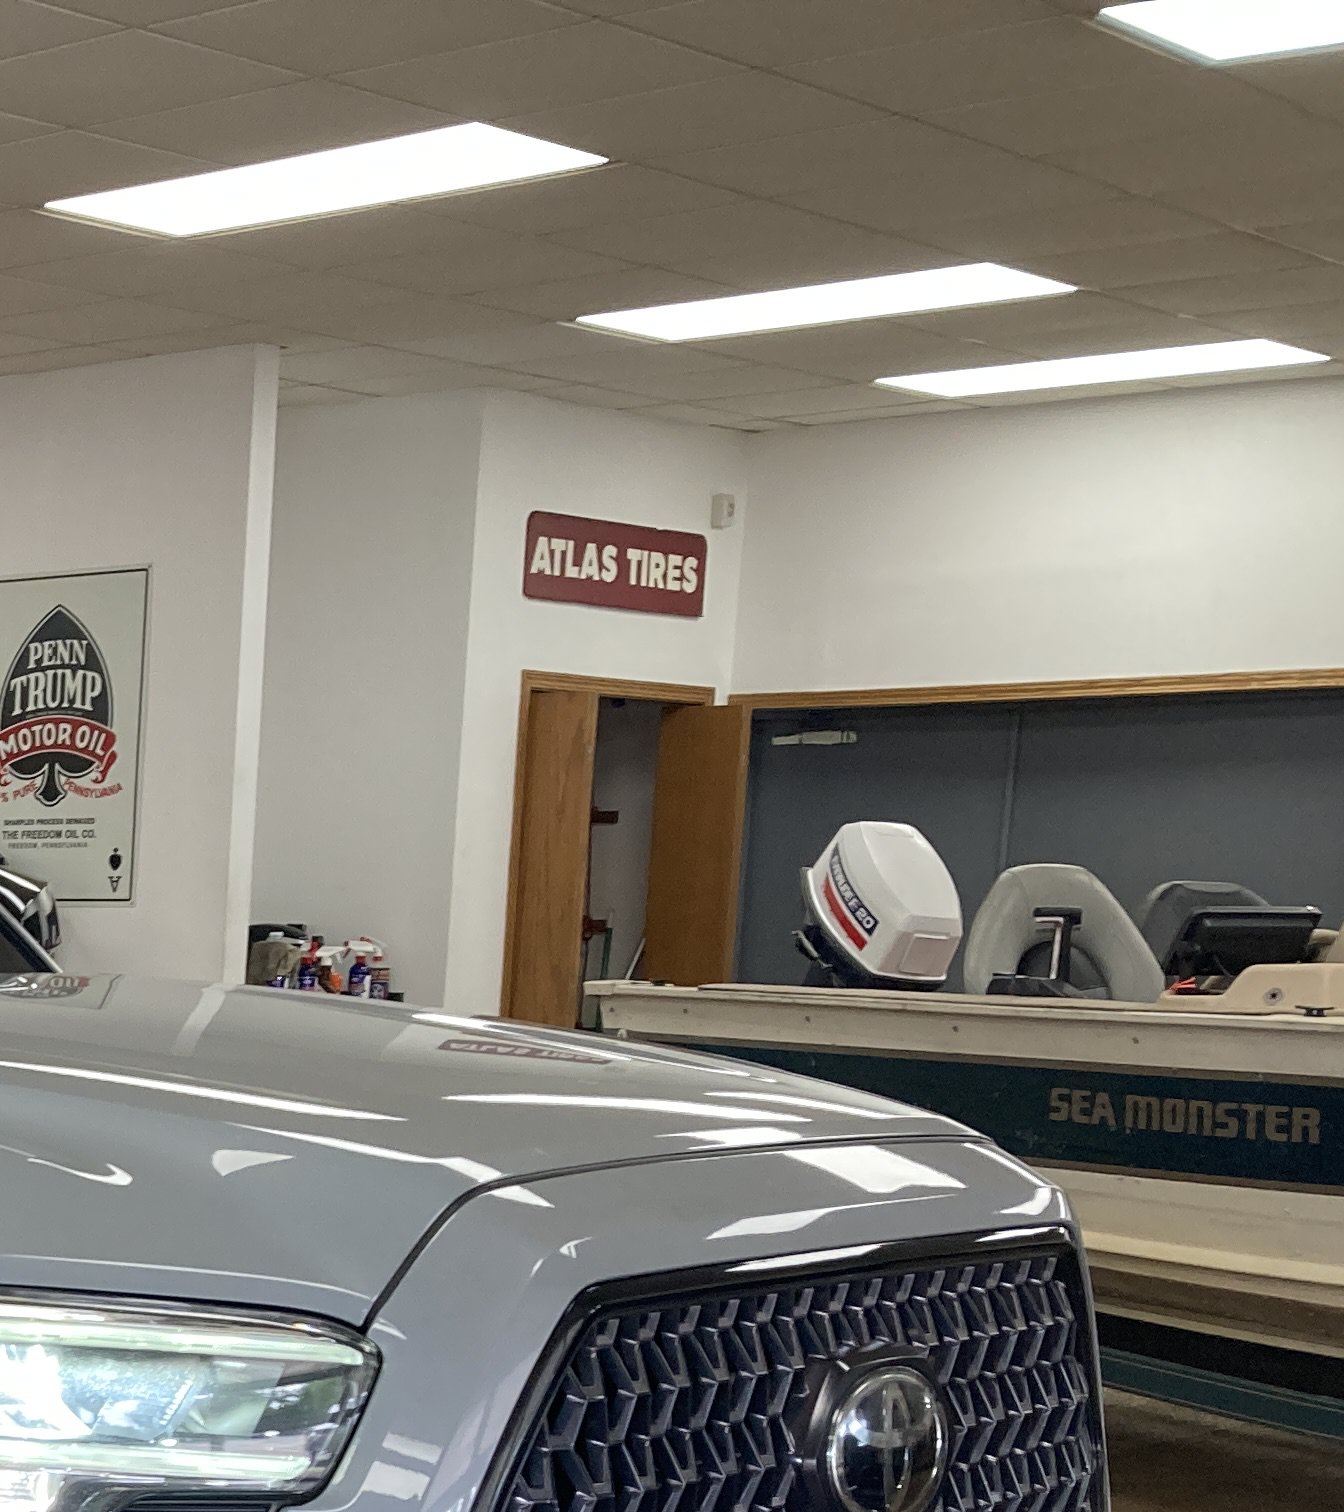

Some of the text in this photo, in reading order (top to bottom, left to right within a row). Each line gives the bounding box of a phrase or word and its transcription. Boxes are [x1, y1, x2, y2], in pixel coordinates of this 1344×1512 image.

[530, 536, 699, 593] ATLAS TIRES
[27, 639, 88, 669] PENN
[10, 668, 103, 716] TRUMP
[75, 725, 106, 757] OIL
[13, 780, 38, 800] PURE
[1, 830, 19, 839] THE
[21, 830, 62, 839] FREEDOM
[65, 830, 79, 839] OIL
[855, 907, 875, 929] 20
[1048, 1087, 1321, 1144] SEA MONSTER
